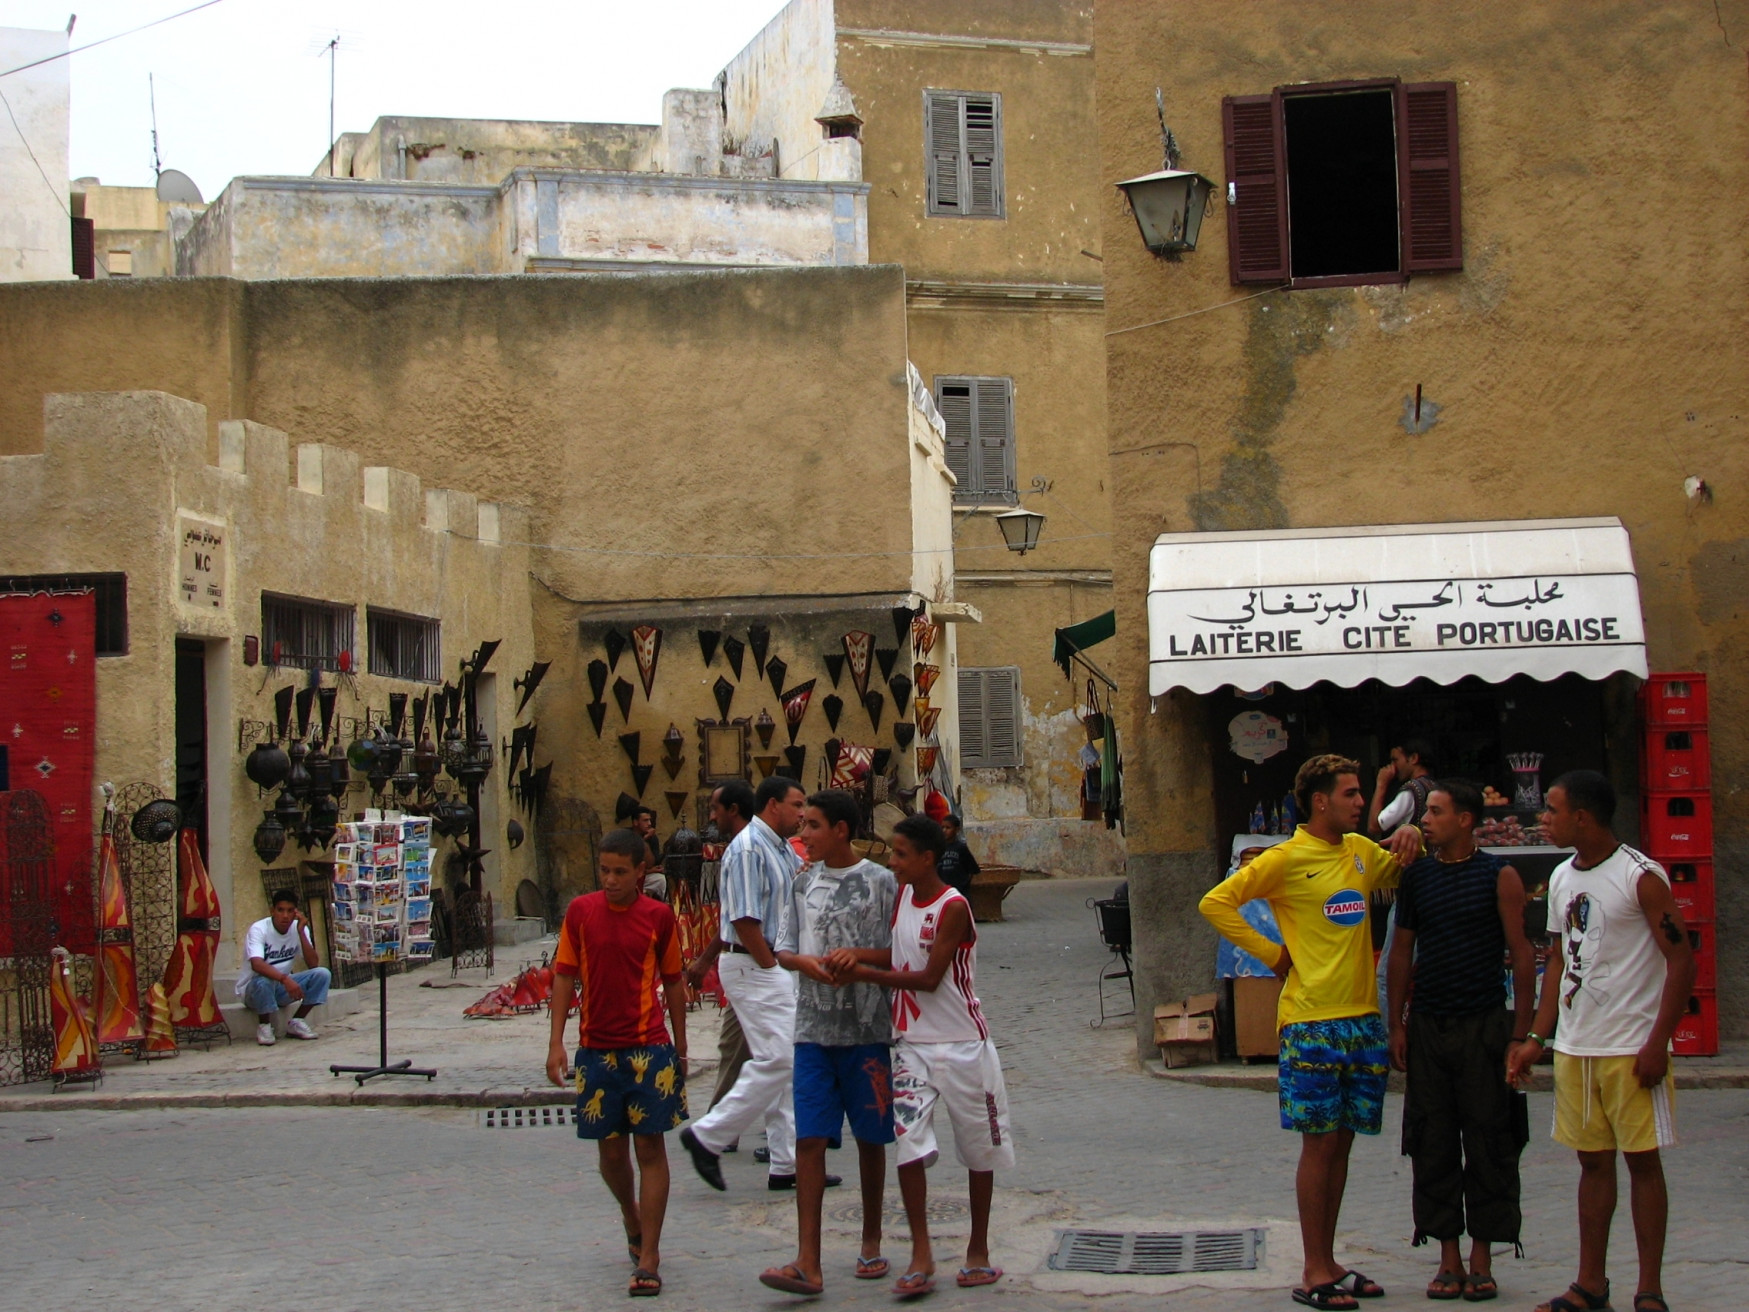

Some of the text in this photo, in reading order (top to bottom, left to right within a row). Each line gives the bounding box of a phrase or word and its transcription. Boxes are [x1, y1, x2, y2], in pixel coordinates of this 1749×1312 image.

[195, 552, 211, 572] W.C
[1186, 578, 1564, 631] محلبة الحي البرتغالي
[1169, 617, 1621, 657] LAITERIE CITE PORTUGAISE
[1325, 902, 1365, 914] TAMOIL
